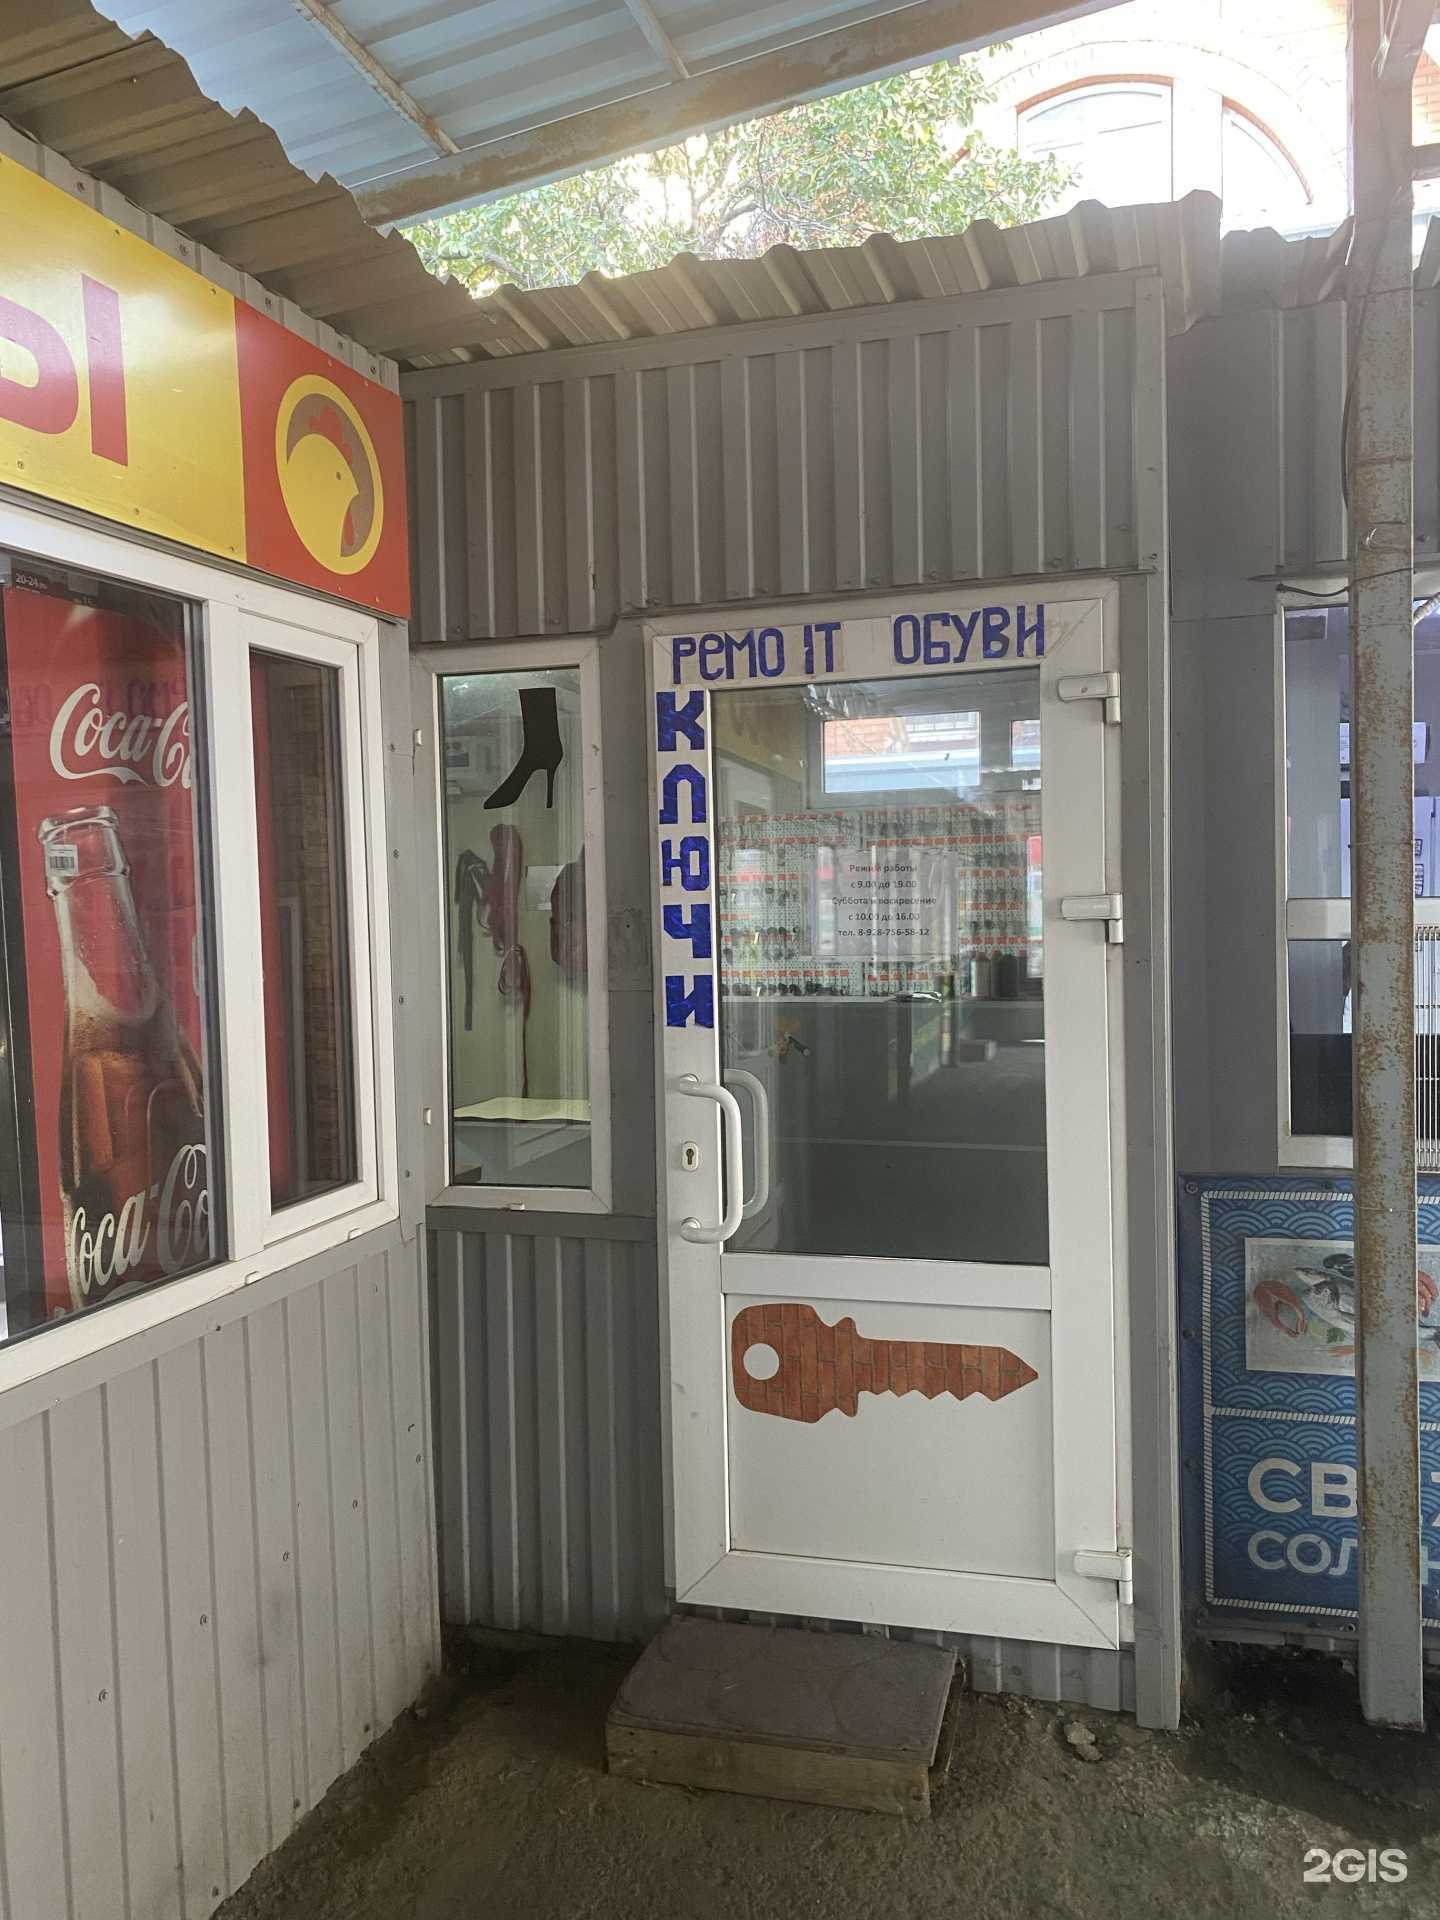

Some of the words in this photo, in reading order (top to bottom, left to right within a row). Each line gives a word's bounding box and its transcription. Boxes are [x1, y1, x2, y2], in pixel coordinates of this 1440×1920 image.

[893, 604, 1044, 665] ОБУВИ
[656, 690, 715, 1028] КЛЮЧИ
[832, 896, 868, 906] Суббота
